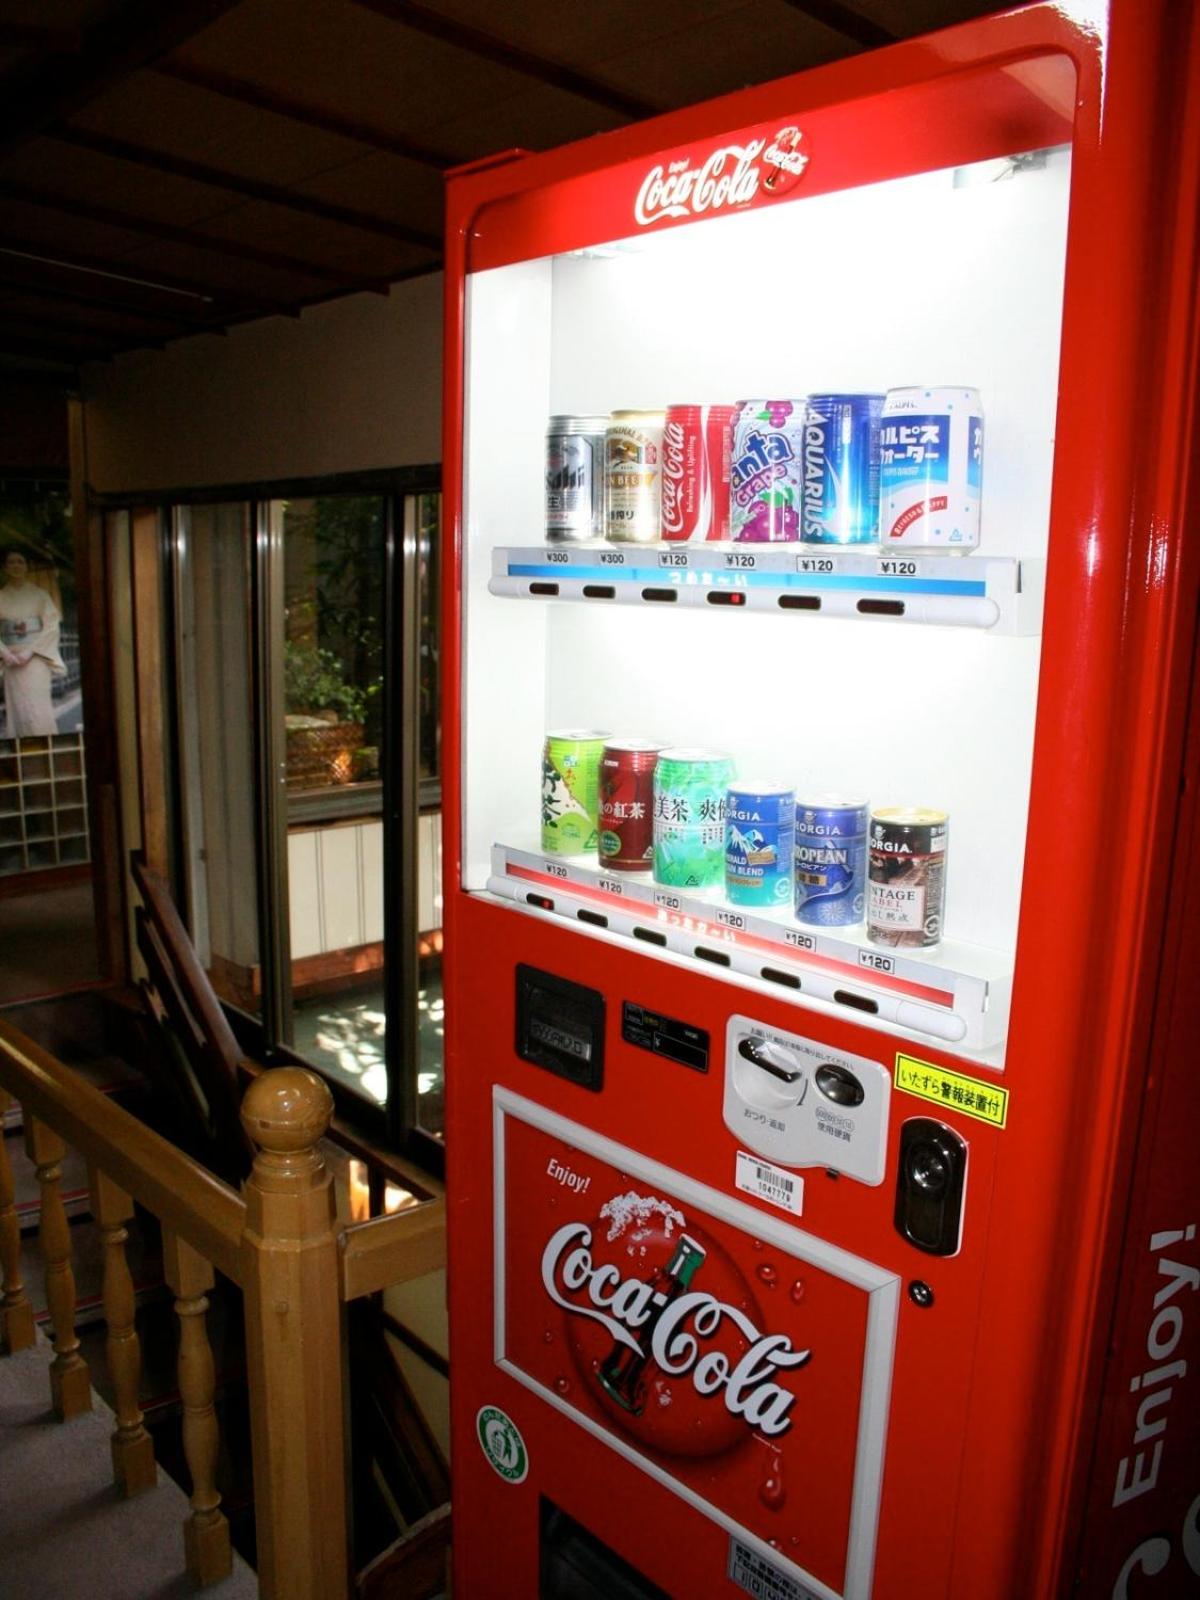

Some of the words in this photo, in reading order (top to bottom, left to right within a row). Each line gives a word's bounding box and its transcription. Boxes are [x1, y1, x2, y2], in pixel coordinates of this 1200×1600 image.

[634, 138, 767, 226] Coca-Cola
[804, 408, 829, 538] AQUARIUS
[736, 463, 788, 508] Grape
[546, 553, 569, 563] ¥300
[600, 553, 625, 565] ¥300
[661, 554, 688, 566] ¥120
[727, 556, 755, 568] ¥120
[802, 558, 834, 572] ¥120
[881, 561, 917, 576] ¥120
[546, 865, 568, 878] ¥120
[599, 879, 622, 894] ¥120
[656, 894, 680, 909] ¥120
[718, 912, 743, 928] ¥120
[786, 932, 813, 949] ¥120
[861, 953, 892, 971] ¥120
[546, 1157, 592, 1195] Enjoy!
[541, 1222, 810, 1435] Coca-Cola
[1112, 1223, 1200, 1508] Enjoy!
